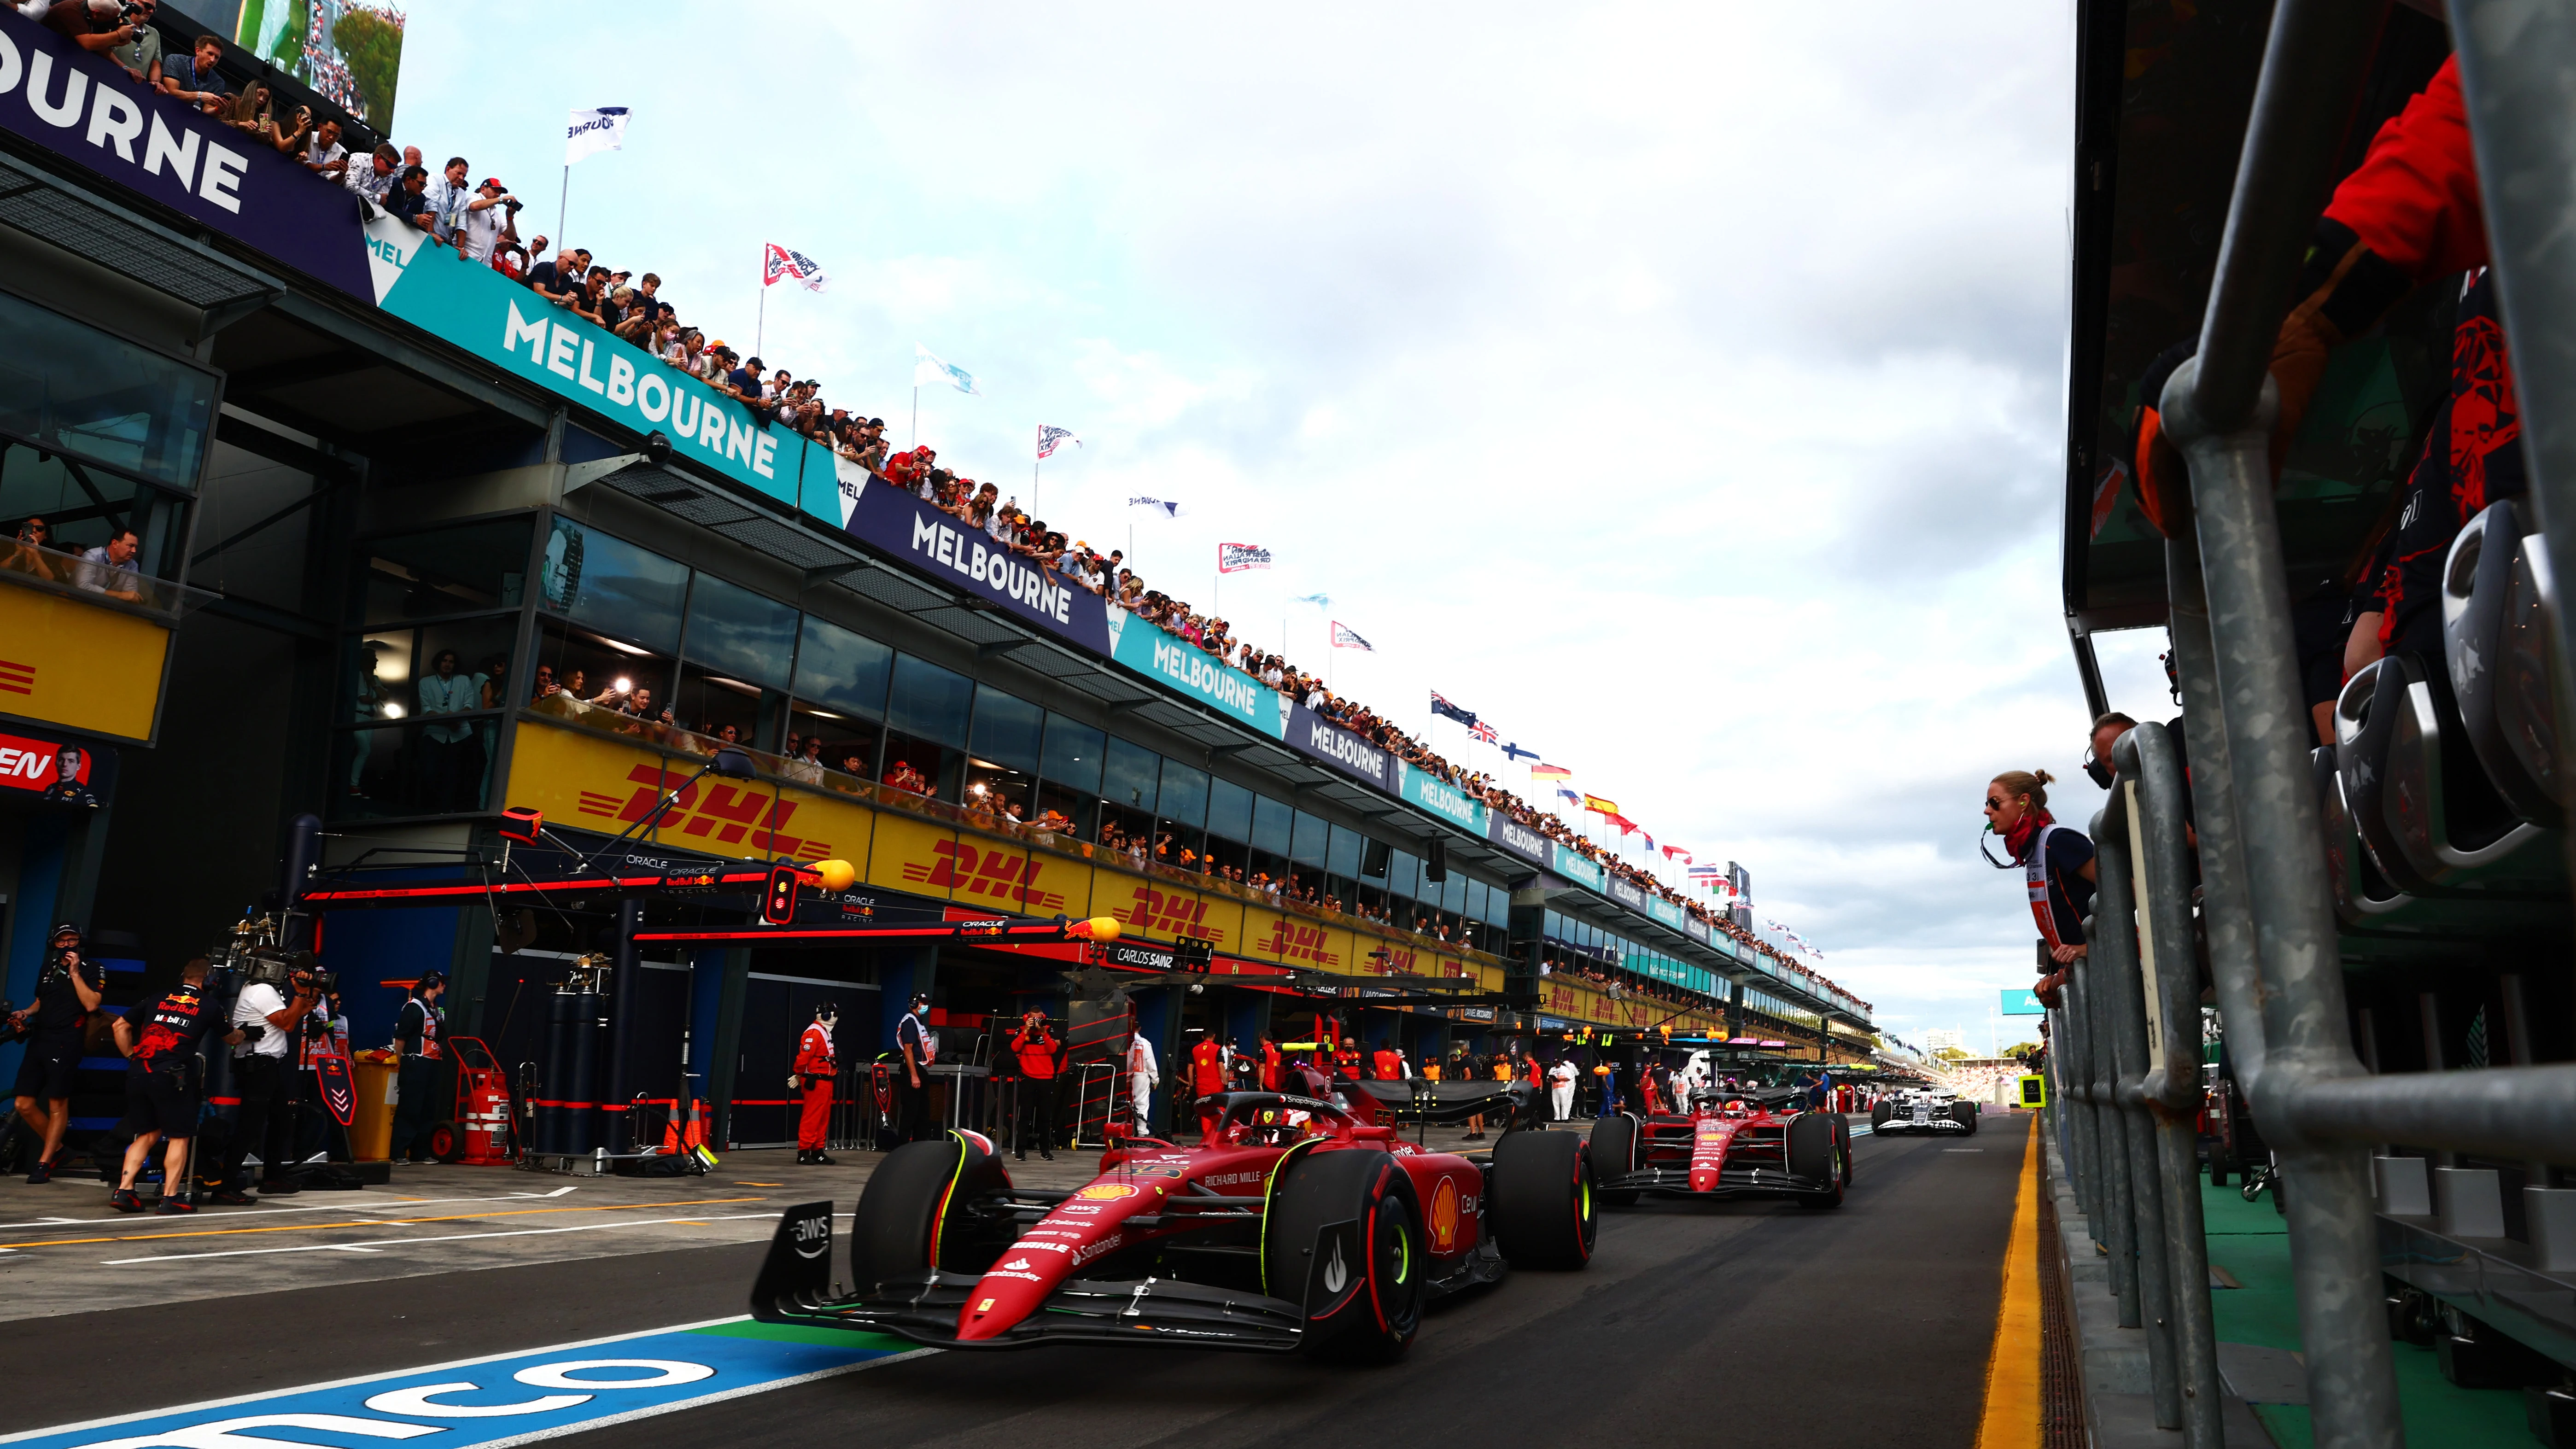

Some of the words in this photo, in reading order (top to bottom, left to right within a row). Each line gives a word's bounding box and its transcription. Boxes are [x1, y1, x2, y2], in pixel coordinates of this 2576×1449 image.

[366, 232, 406, 270] MEL
[503, 298, 777, 479] MELBOURNE
[838, 478, 859, 500] MEL
[912, 510, 1072, 625] MELBOURNE
[1154, 637, 1256, 716] MELBOURNE
[1311, 720, 1383, 779] MELBOURNE
[617, 764, 803, 855] DHL
[1420, 779, 1473, 824] MELBOURNE
[1503, 821, 1543, 857] MELBOURNE
[626, 854, 668, 869] ORACLE
[927, 839, 1046, 905] DHL
[1566, 856, 1598, 885] MELBOURNE
[667, 877, 678, 886] Red
[680, 876, 693, 885] Bull
[1615, 880, 1641, 906] MELBOURNE
[844, 894, 875, 906] ORACLE
[1655, 900, 1676, 924] MELBOURNE
[841, 915, 873, 923] RACING
[1127, 887, 1210, 939] DHL
[1688, 919, 1706, 939] MELBOURNE
[1269, 921, 1329, 964] DHL
[1117, 948, 1150, 964] CARLOS
[1149, 953, 1174, 968] SAINZ
[1373, 946, 1425, 976] DHL
[158, 1001, 178, 1011] Red
[177, 1004, 199, 1016] Bull
[1551, 987, 1575, 1012] DHL
[1595, 998, 1615, 1021] DHL
[154, 1014, 180, 1024] Mobil
[1287, 1096, 1324, 1108] Snapdragon
[1104, 1165, 1190, 1179] 55
[1204, 1173, 1238, 1187] RICHARD
[1239, 1171, 1261, 1183] MILLE
[1009, 1242, 1070, 1253] MAHLE
[1081, 1234, 1122, 1261] Santander
[1156, 1327, 1237, 1336] V-Power
